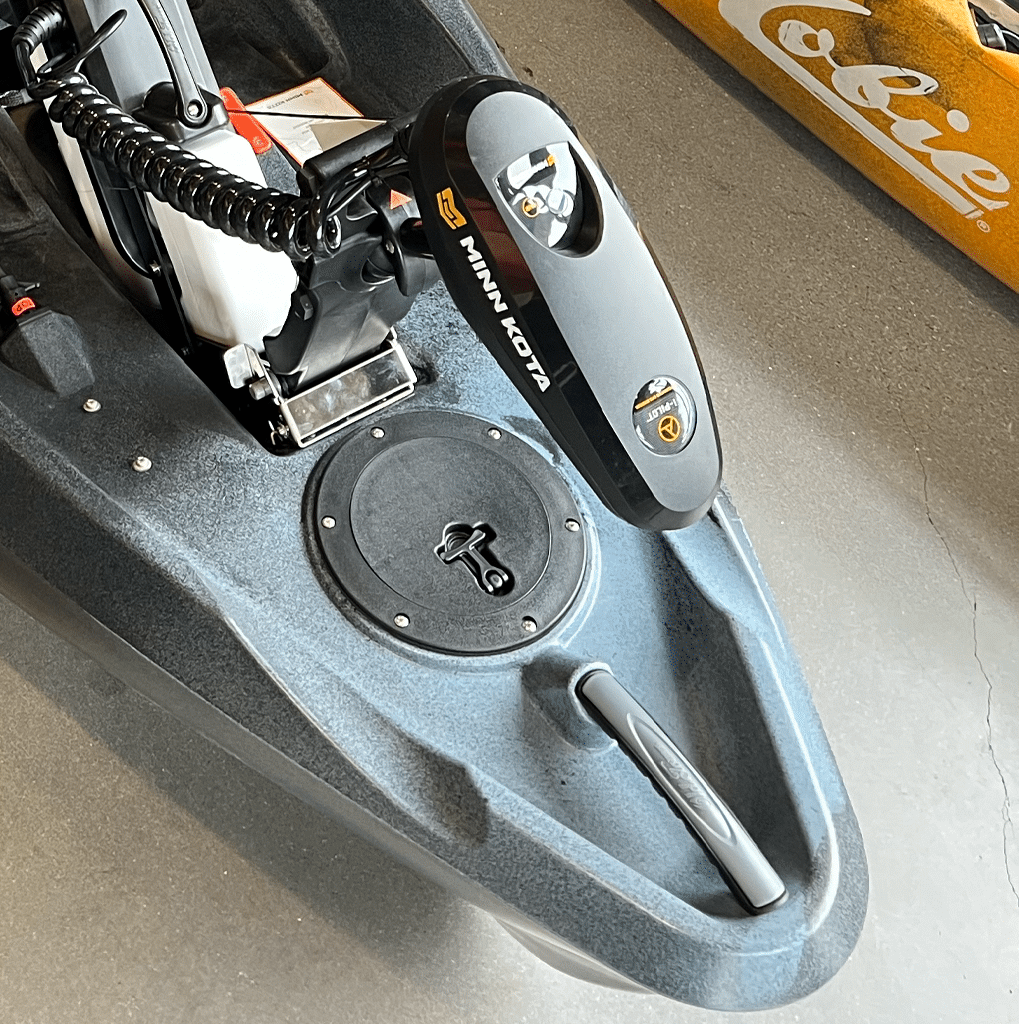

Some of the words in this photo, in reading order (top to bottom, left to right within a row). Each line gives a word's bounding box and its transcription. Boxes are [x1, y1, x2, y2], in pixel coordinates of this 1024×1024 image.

[459, 235, 509, 313] MINN
[500, 316, 551, 393] KOTA
[646, 398, 678, 423] I-PILOT
